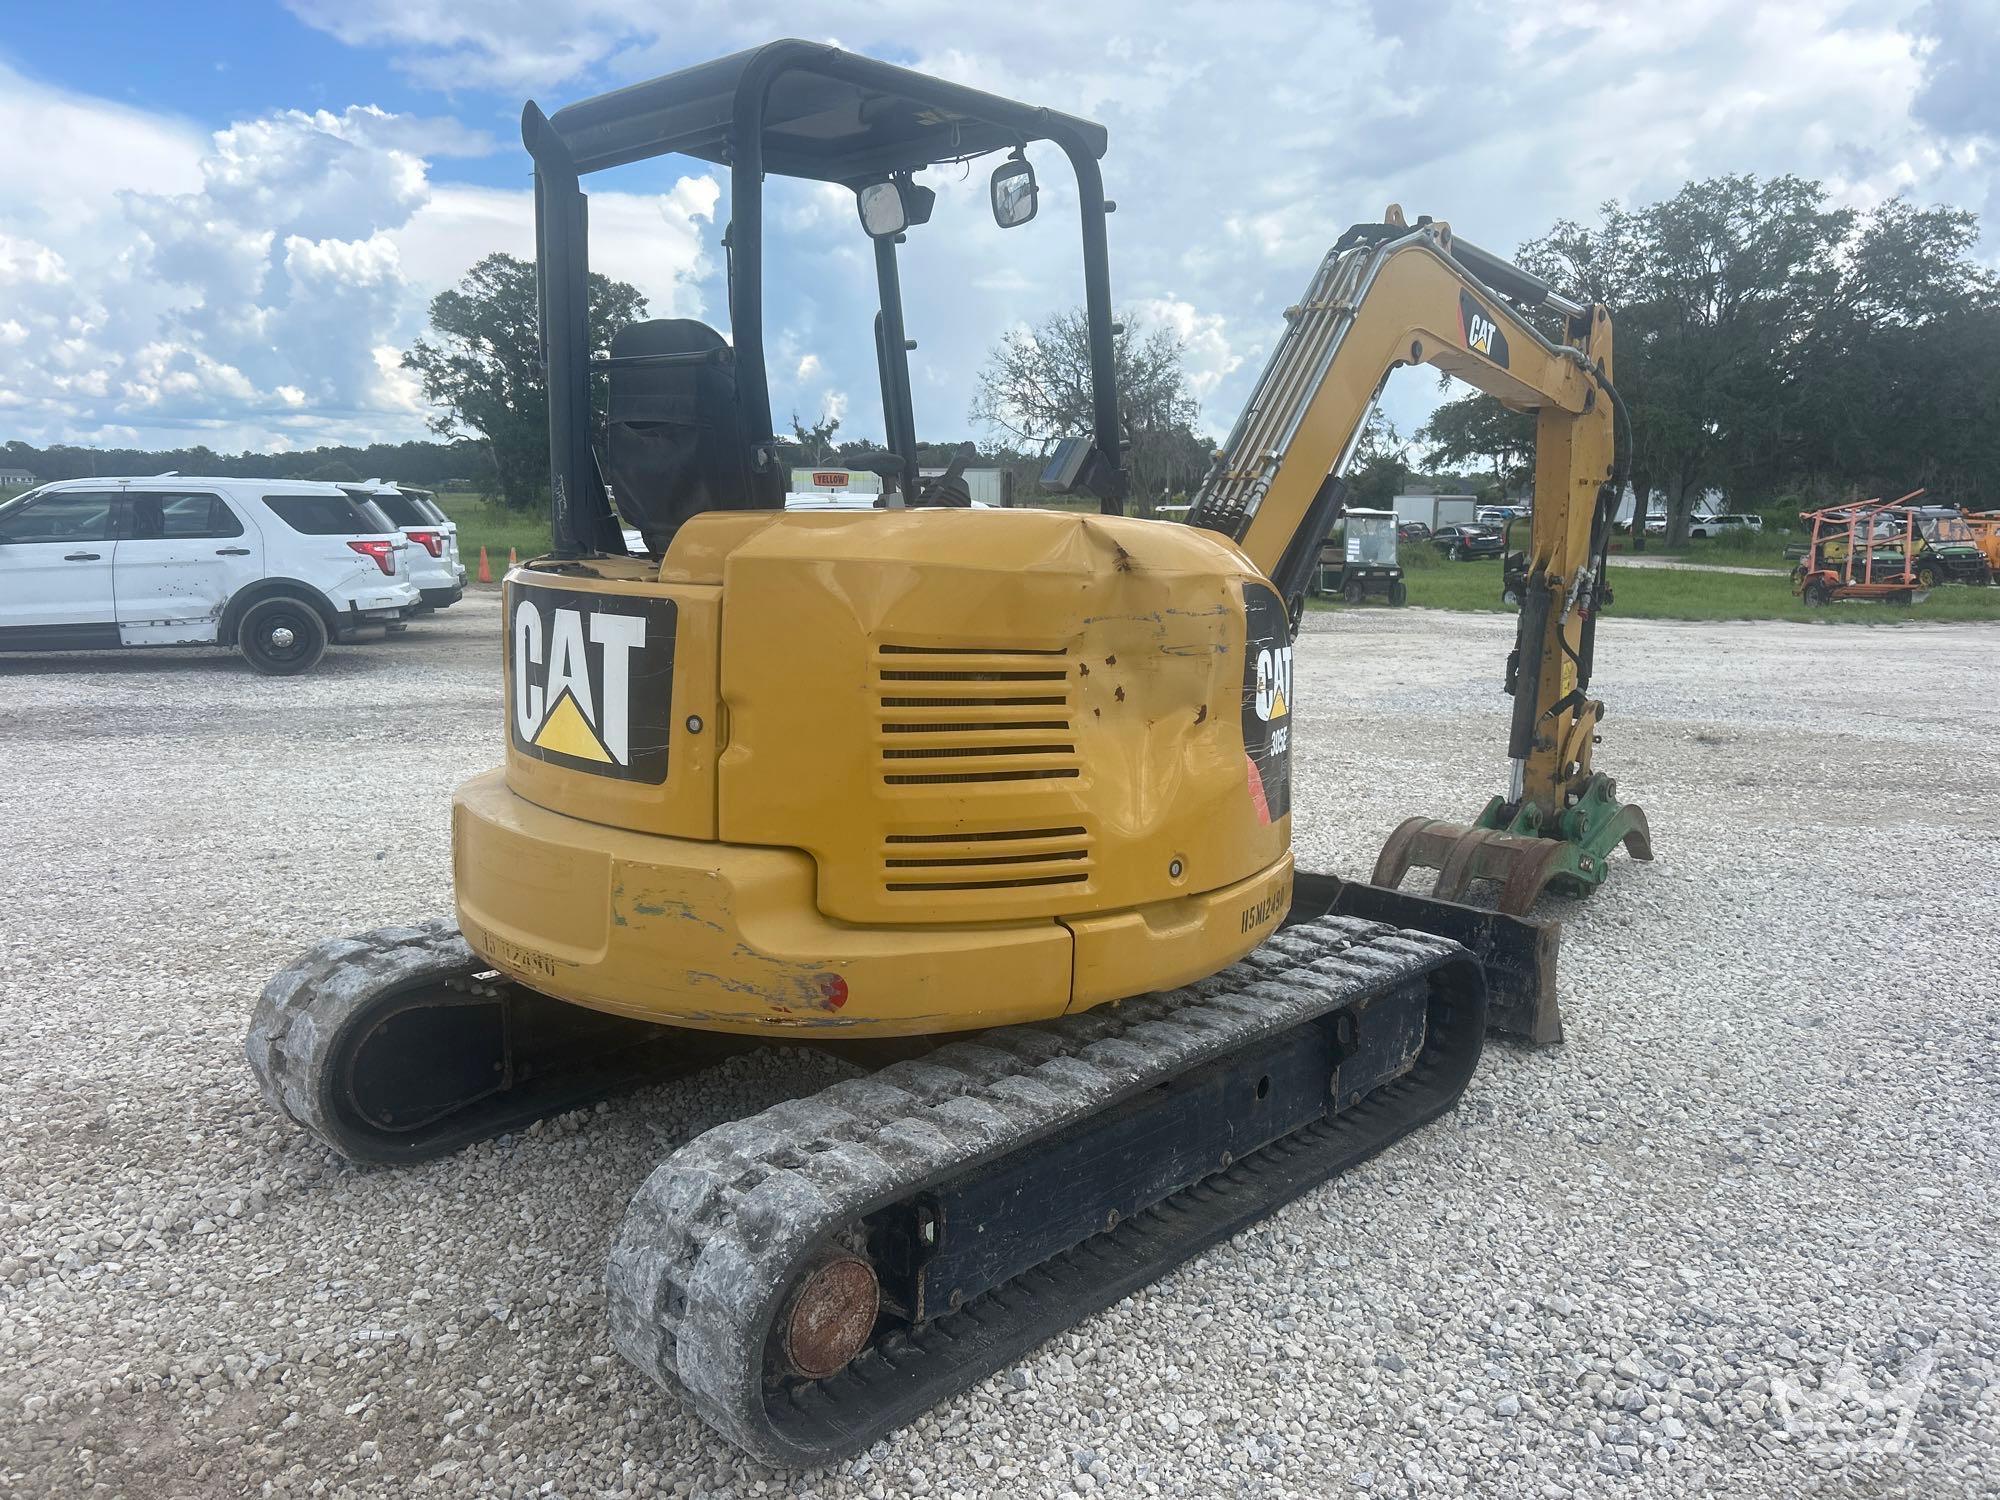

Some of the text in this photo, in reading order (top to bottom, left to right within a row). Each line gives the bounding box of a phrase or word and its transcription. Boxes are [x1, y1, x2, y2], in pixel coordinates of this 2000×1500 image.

[1469, 314, 1496, 356] CAT
[817, 475, 845, 485] YELLOW
[515, 600, 647, 766] CAT
[1255, 647, 1292, 722] CAT
